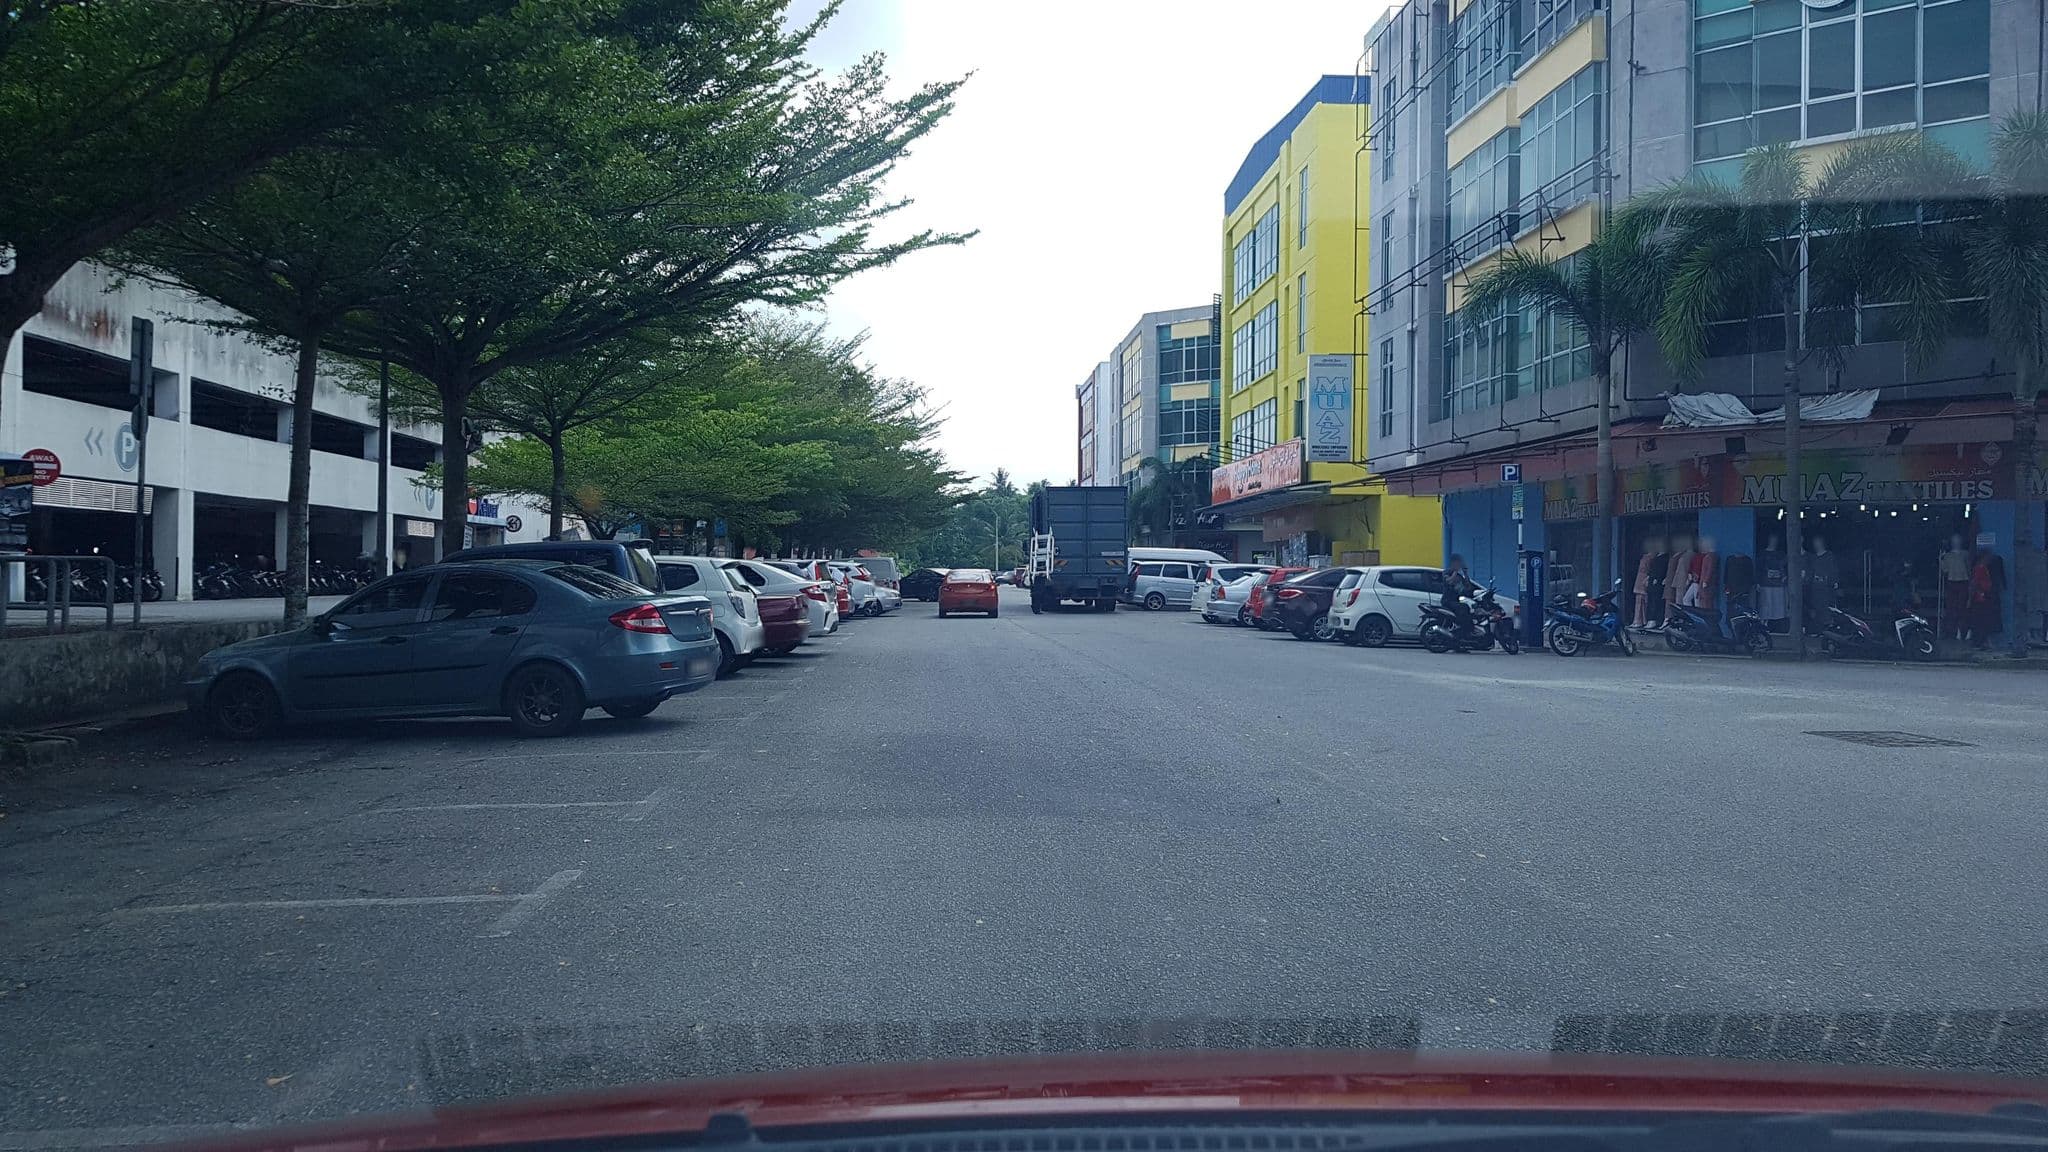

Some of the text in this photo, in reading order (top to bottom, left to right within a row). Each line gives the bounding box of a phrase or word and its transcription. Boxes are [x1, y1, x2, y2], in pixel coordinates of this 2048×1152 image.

[1315, 376, 1346, 444] MUAZ
[122, 432, 136, 463] P
[1505, 466, 1516, 480] P
[1741, 472, 1864, 504] MUAZ
[1624, 488, 1710, 514] MUAZ TEXTILES
